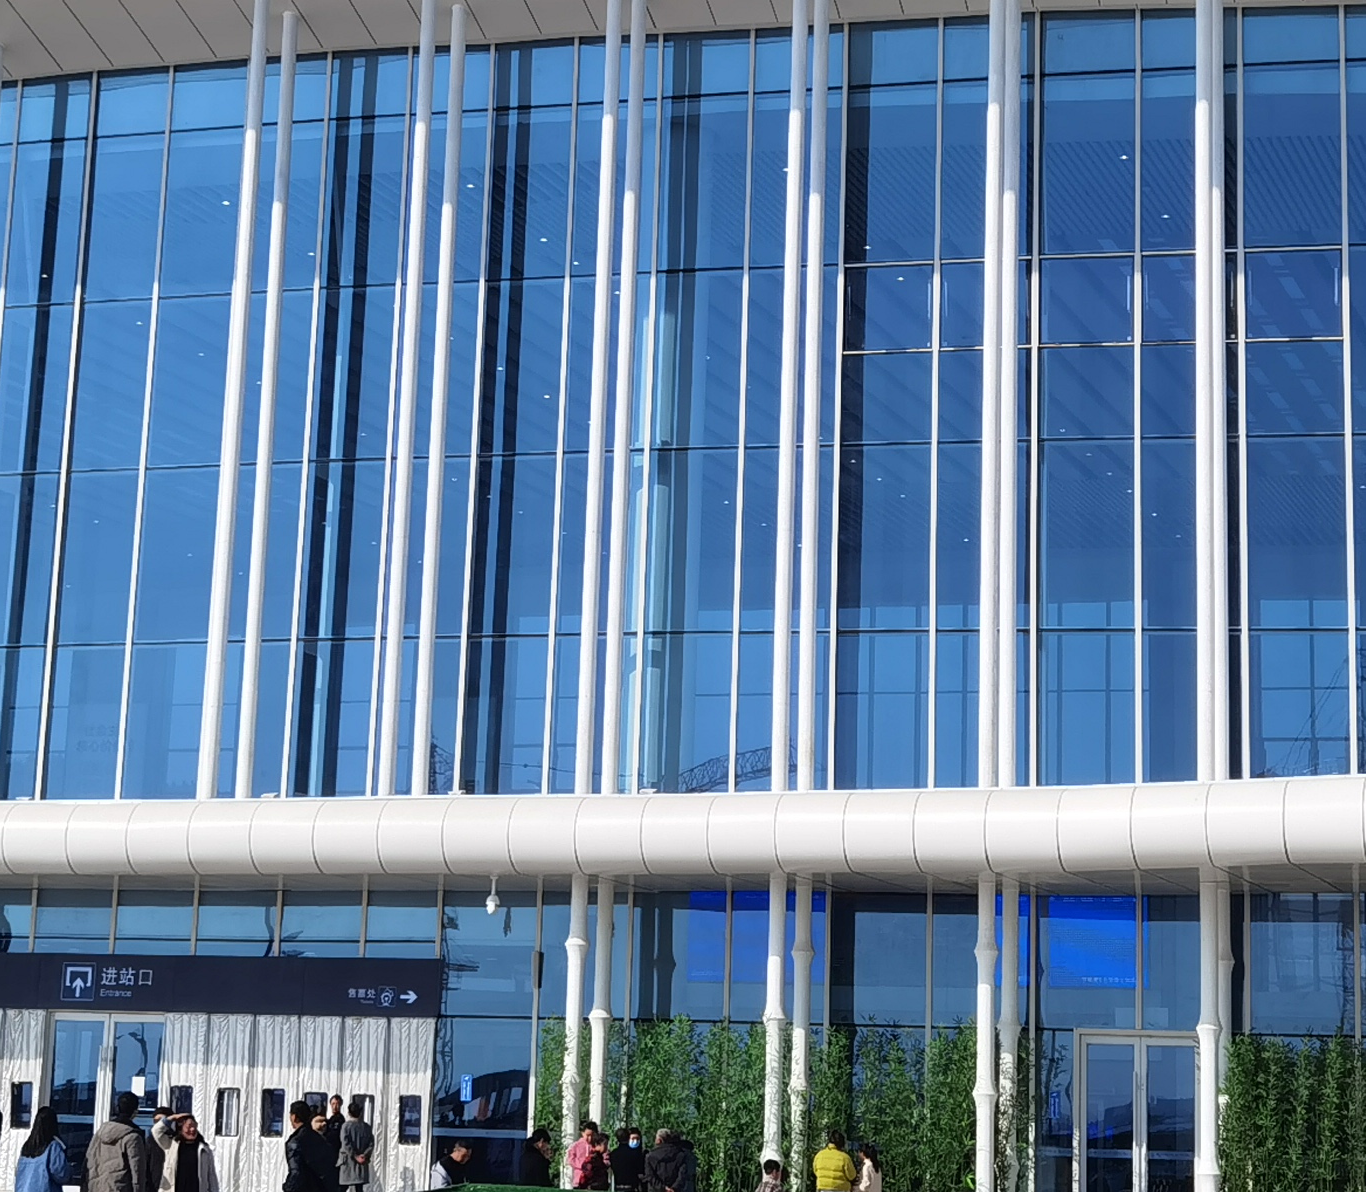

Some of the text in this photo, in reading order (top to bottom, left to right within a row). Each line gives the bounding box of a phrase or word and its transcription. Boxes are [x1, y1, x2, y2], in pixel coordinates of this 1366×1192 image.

[100, 966, 153, 986] 进站口
[99, 988, 133, 998] Entrance
